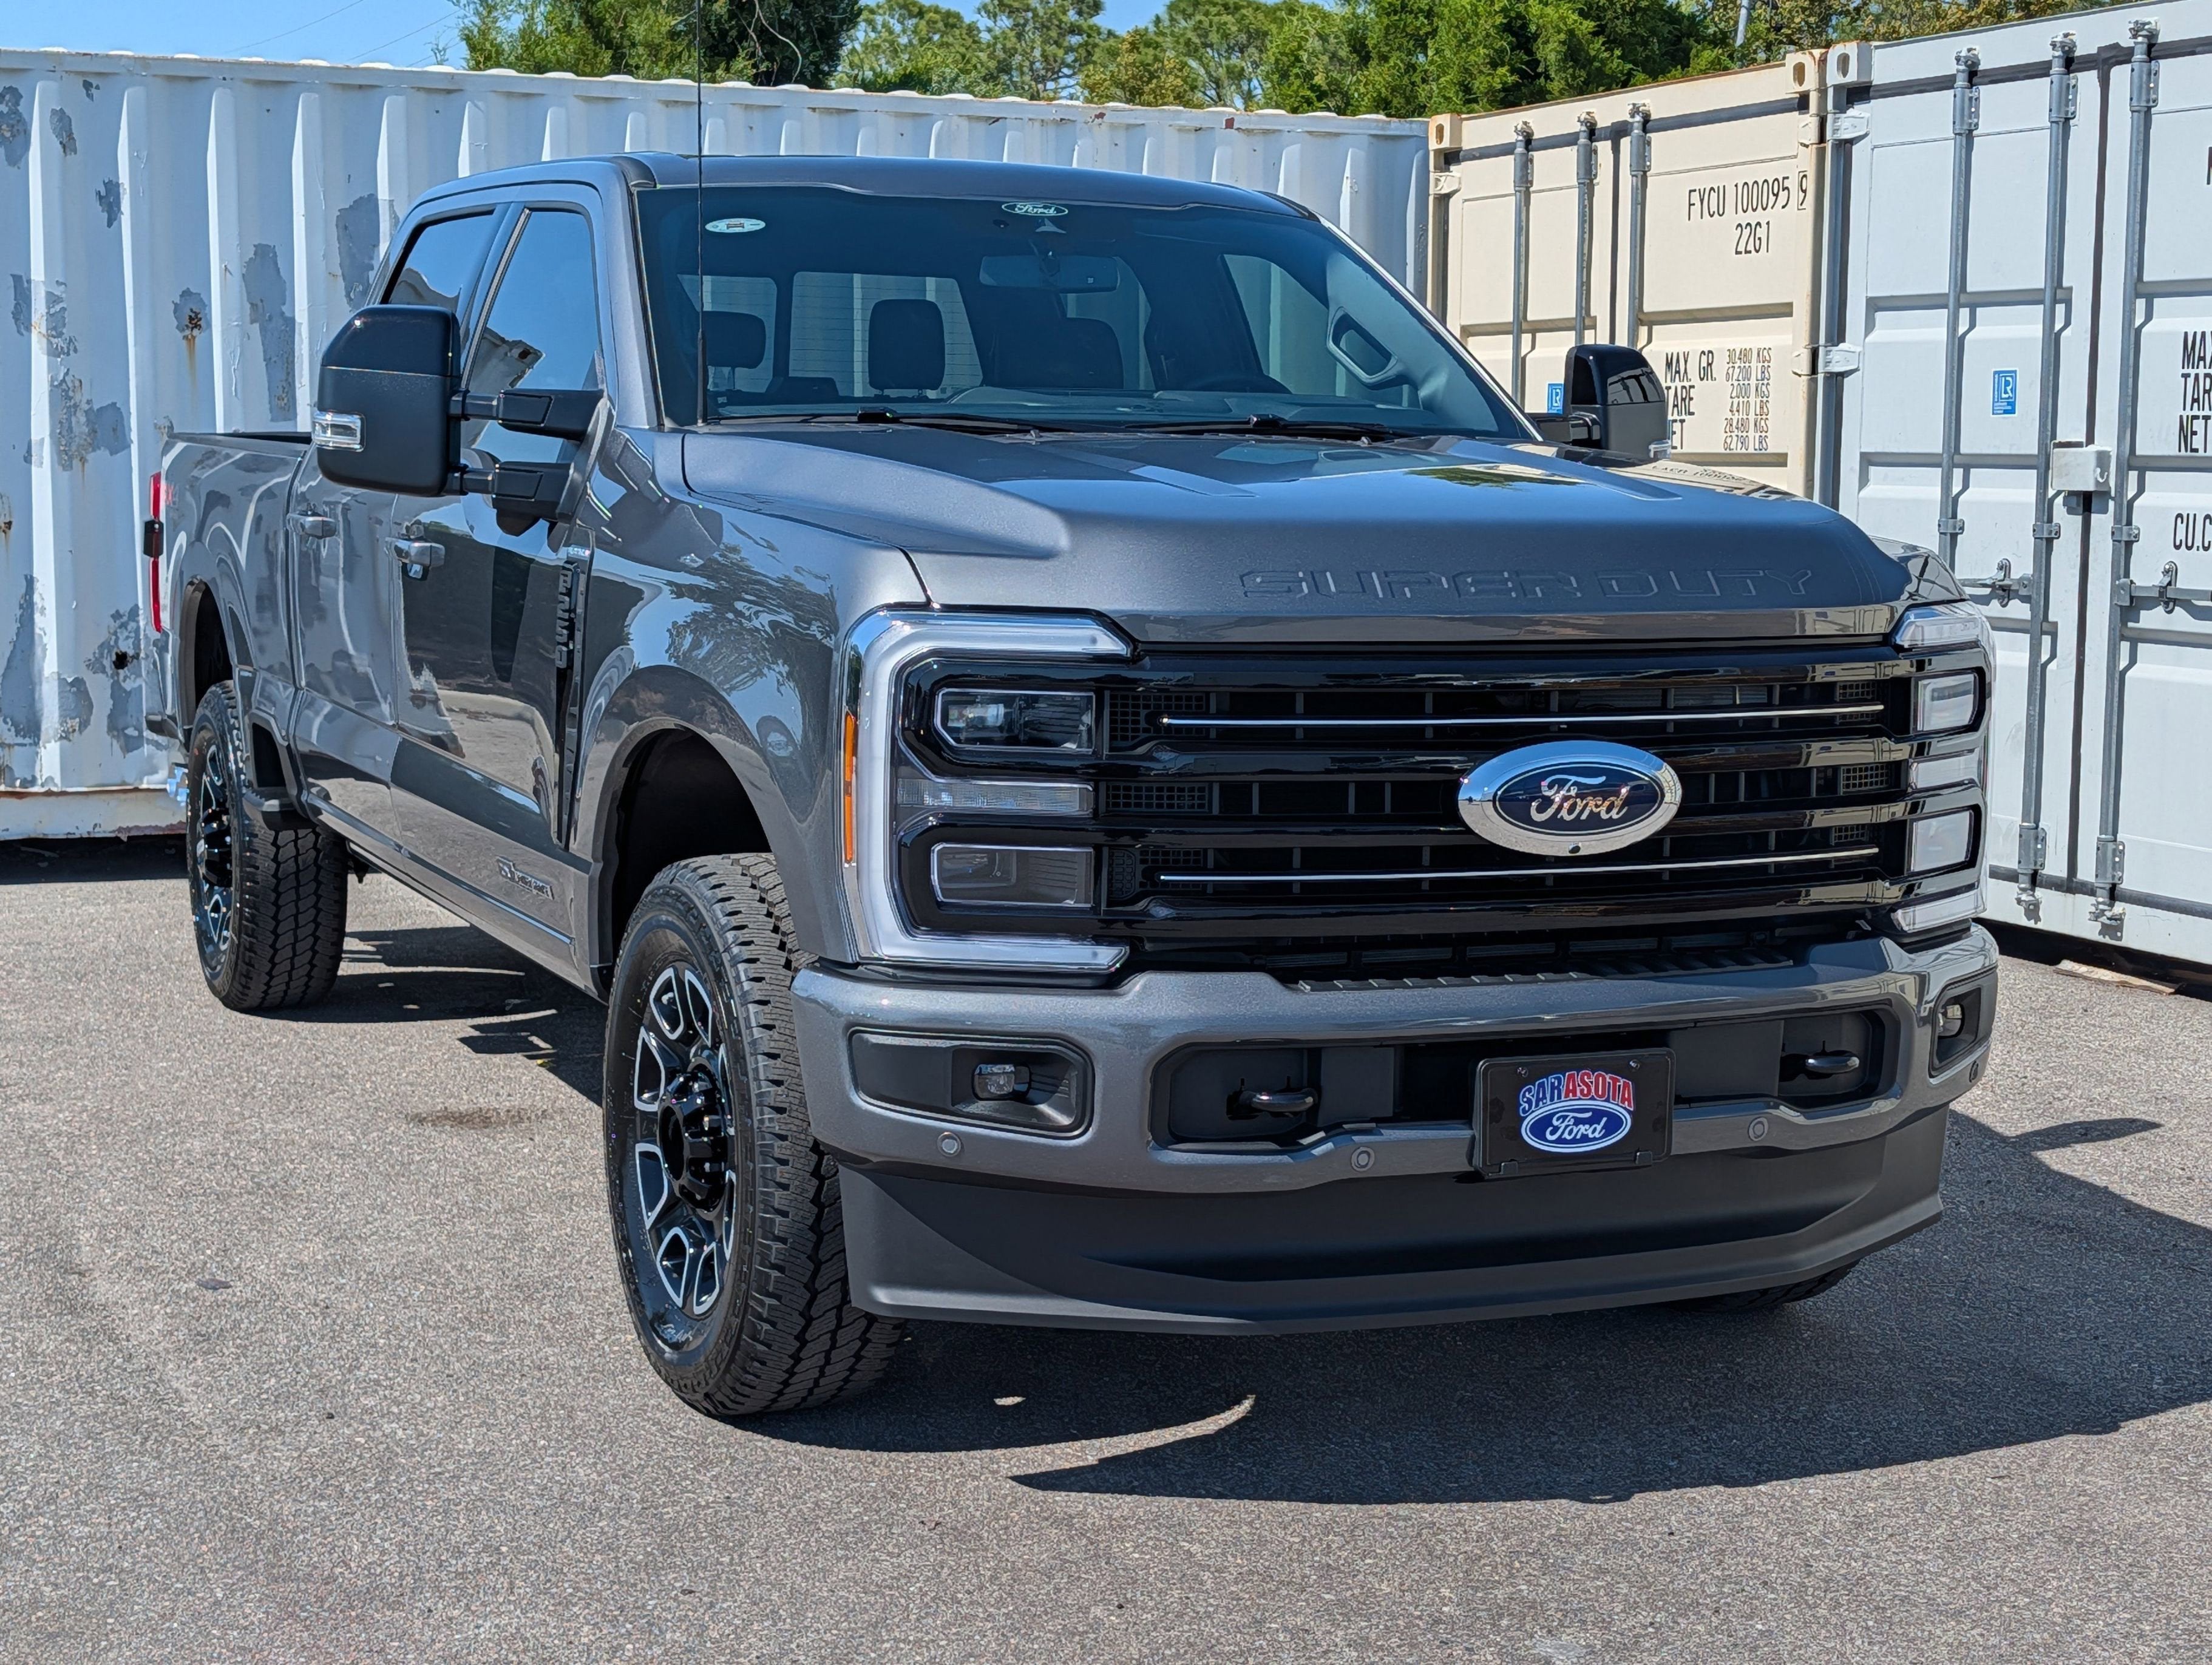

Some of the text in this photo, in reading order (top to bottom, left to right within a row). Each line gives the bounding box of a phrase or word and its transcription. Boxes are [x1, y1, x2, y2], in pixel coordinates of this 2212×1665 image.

[1014, 203, 1057, 214] Ford
[1688, 174, 1808, 221] FYCU 100095 9
[1734, 220, 1770, 255] 22G1
[1664, 350, 1717, 383] MAX. GR.
[1756, 347, 1772, 364] KGS
[1756, 365, 1771, 381] LBS
[1665, 385, 1695, 416] TARE
[1755, 382, 1770, 399] KGS
[1754, 400, 1769, 416] LBS
[1668, 419, 1686, 450] ET
[1754, 418, 1768, 433] KGS
[2178, 415, 2211, 453] NET
[1753, 435, 1768, 451] LBS
[1239, 569, 1812, 599] SUPER DUTY
[1530, 774, 1629, 822] Ford
[1519, 1070, 1634, 1117] SARASOTA
[1545, 1111, 1608, 1141] Ford
